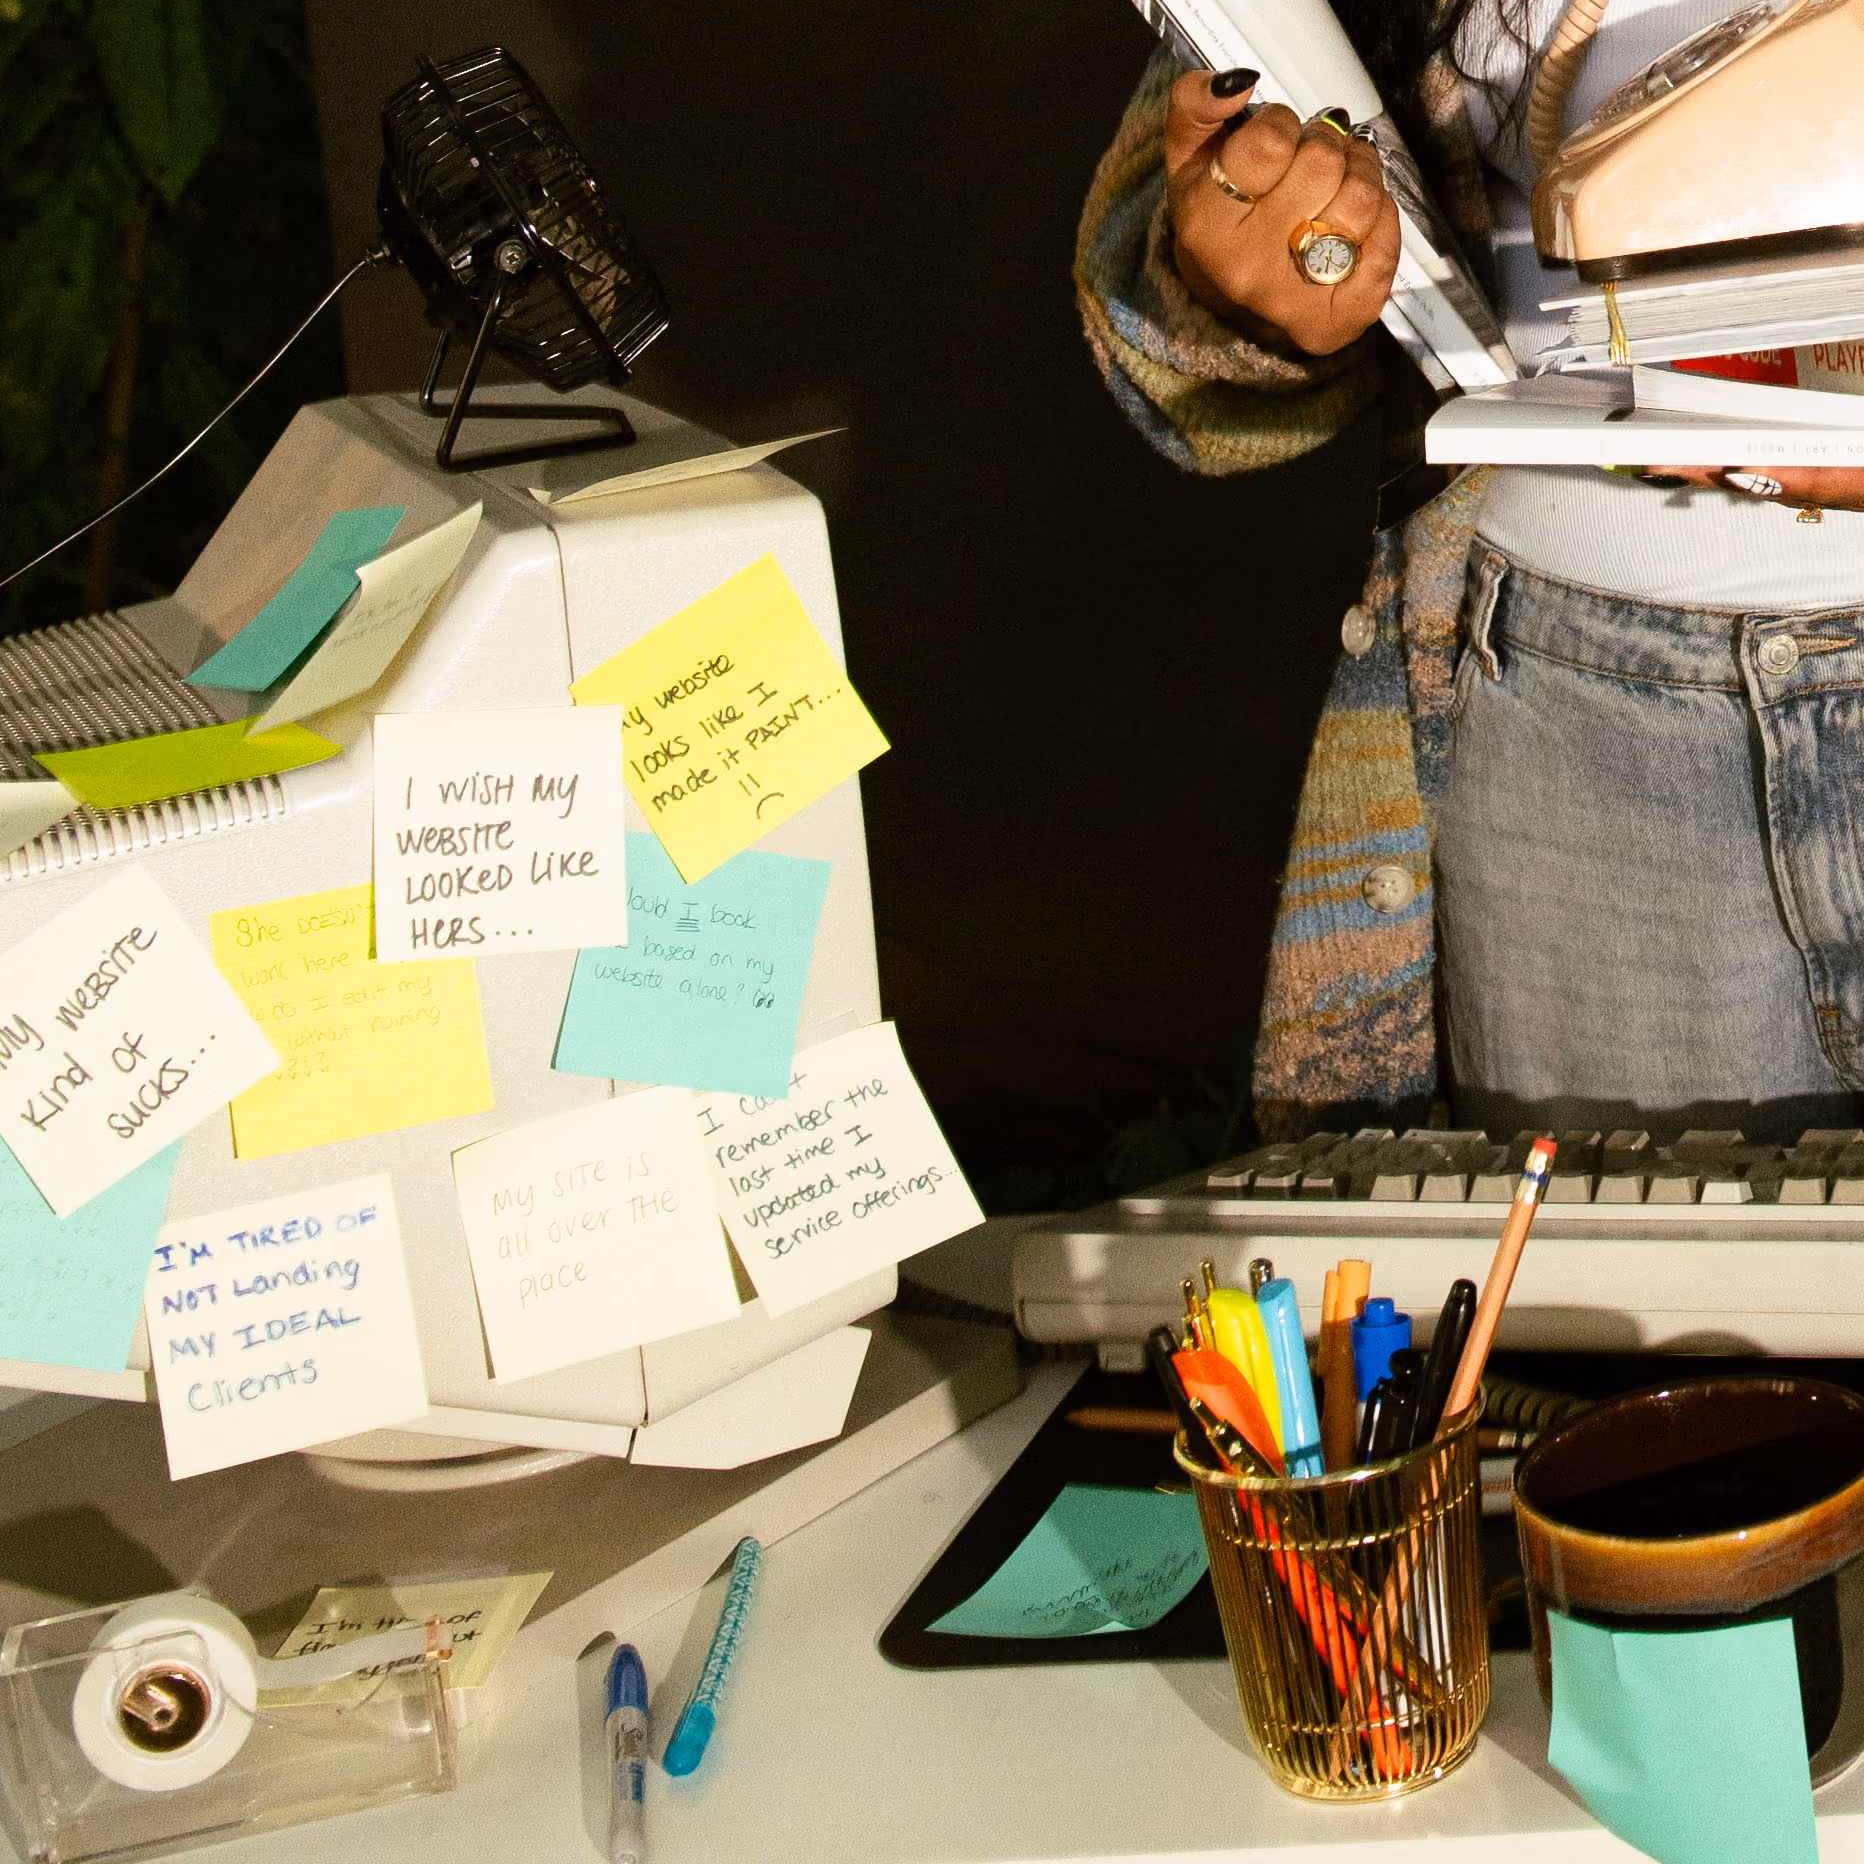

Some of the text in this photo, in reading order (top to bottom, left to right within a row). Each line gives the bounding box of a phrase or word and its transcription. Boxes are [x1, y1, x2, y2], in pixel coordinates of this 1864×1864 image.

[654, 654, 735, 709] website
[747, 681, 778, 707] I
[406, 776, 413, 810] I
[652, 768, 718, 813] made
[717, 748, 740, 771] it
[237, 918, 282, 947] She
[710, 903, 757, 929] book
[303, 952, 349, 973] here
[594, 962, 663, 989] website
[643, 935, 774, 985] based on my
[696, 1107, 724, 1137] I
[715, 1077, 889, 1168] remember the
[728, 1124, 873, 1197] last time I
[743, 1157, 886, 1229] updated my
[154, 1205, 377, 1272] I'M TIRED OF
[499, 1229, 529, 1259] all
[548, 1208, 611, 1243] over
[764, 1209, 843, 1260] service
[162, 1258, 360, 1315] NOT Landing
[520, 1261, 588, 1310] place
[233, 1306, 362, 1351] IDEAL
[188, 1358, 318, 1412] Clients
